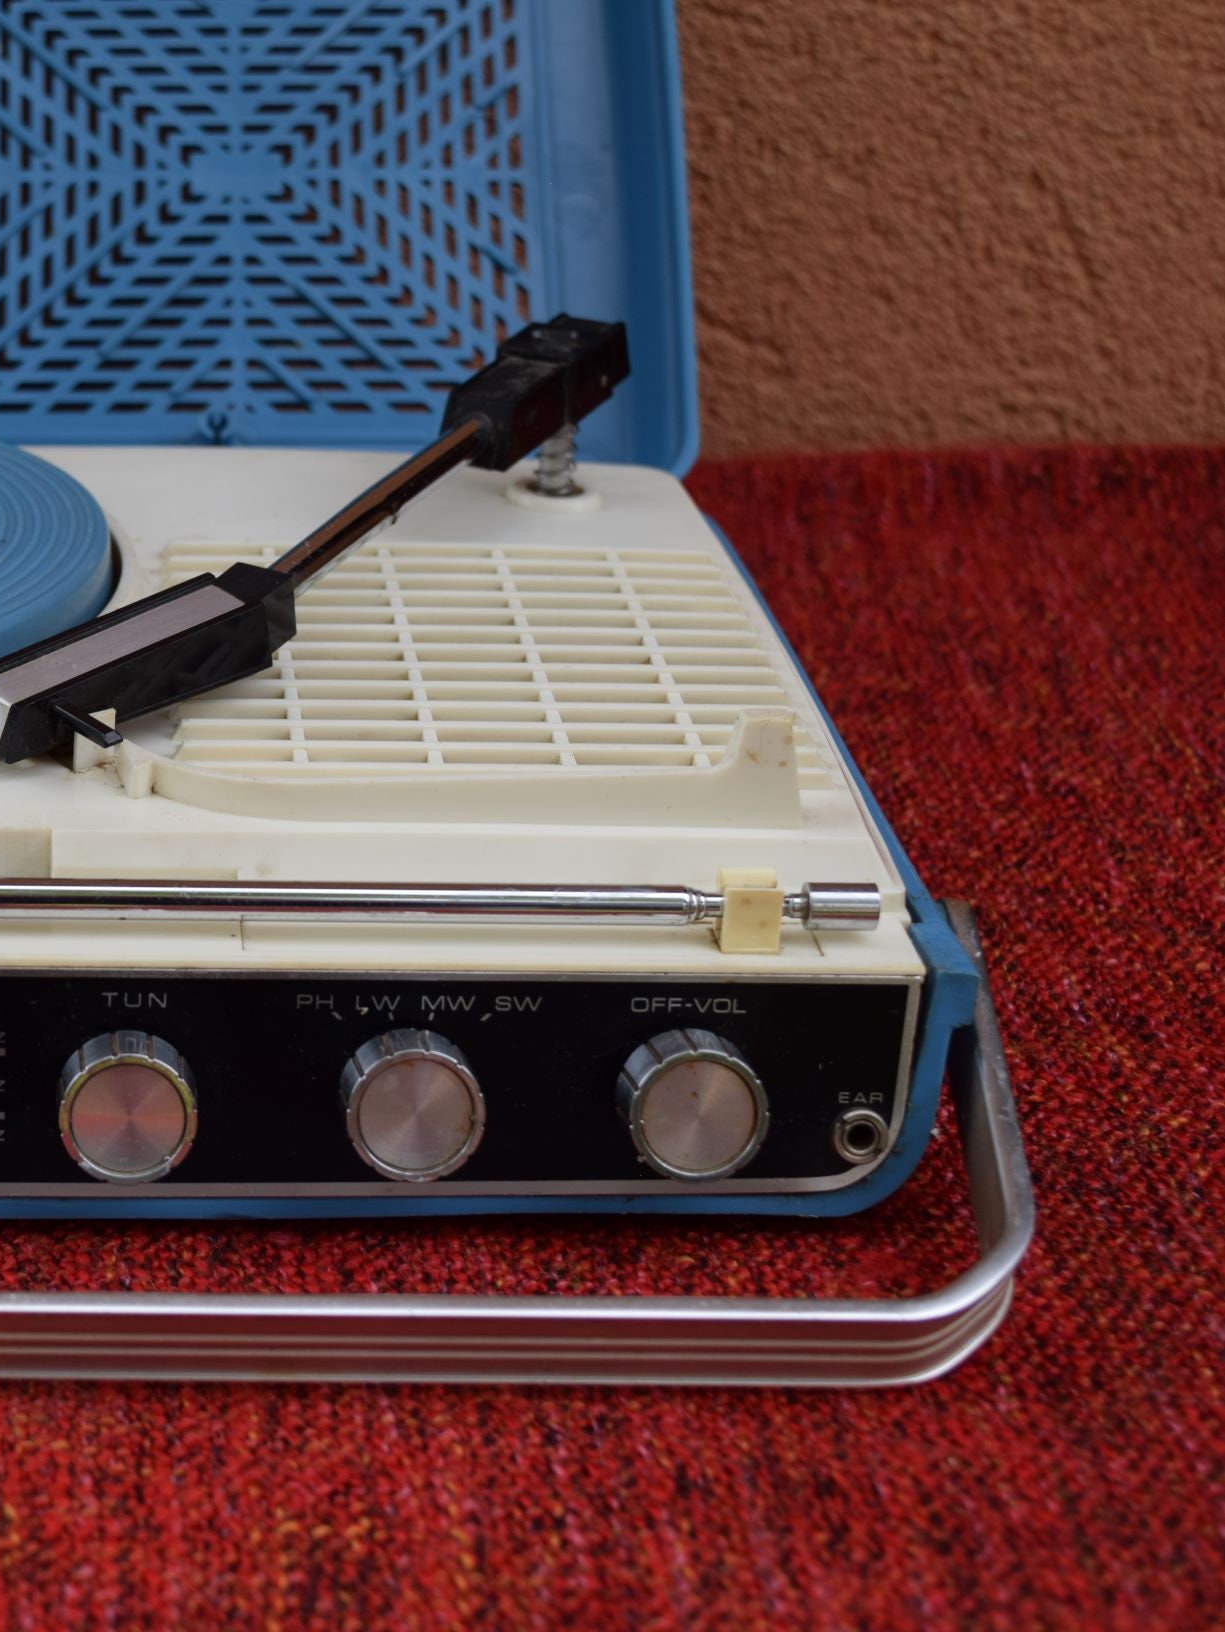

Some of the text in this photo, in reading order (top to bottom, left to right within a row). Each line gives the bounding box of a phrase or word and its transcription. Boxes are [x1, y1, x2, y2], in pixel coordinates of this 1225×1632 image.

[101, 991, 168, 1009] TUN
[296, 993, 543, 1012] PH LW MW SW
[630, 997, 747, 1014] OFF-VOL
[838, 1090, 884, 1104] EAR
